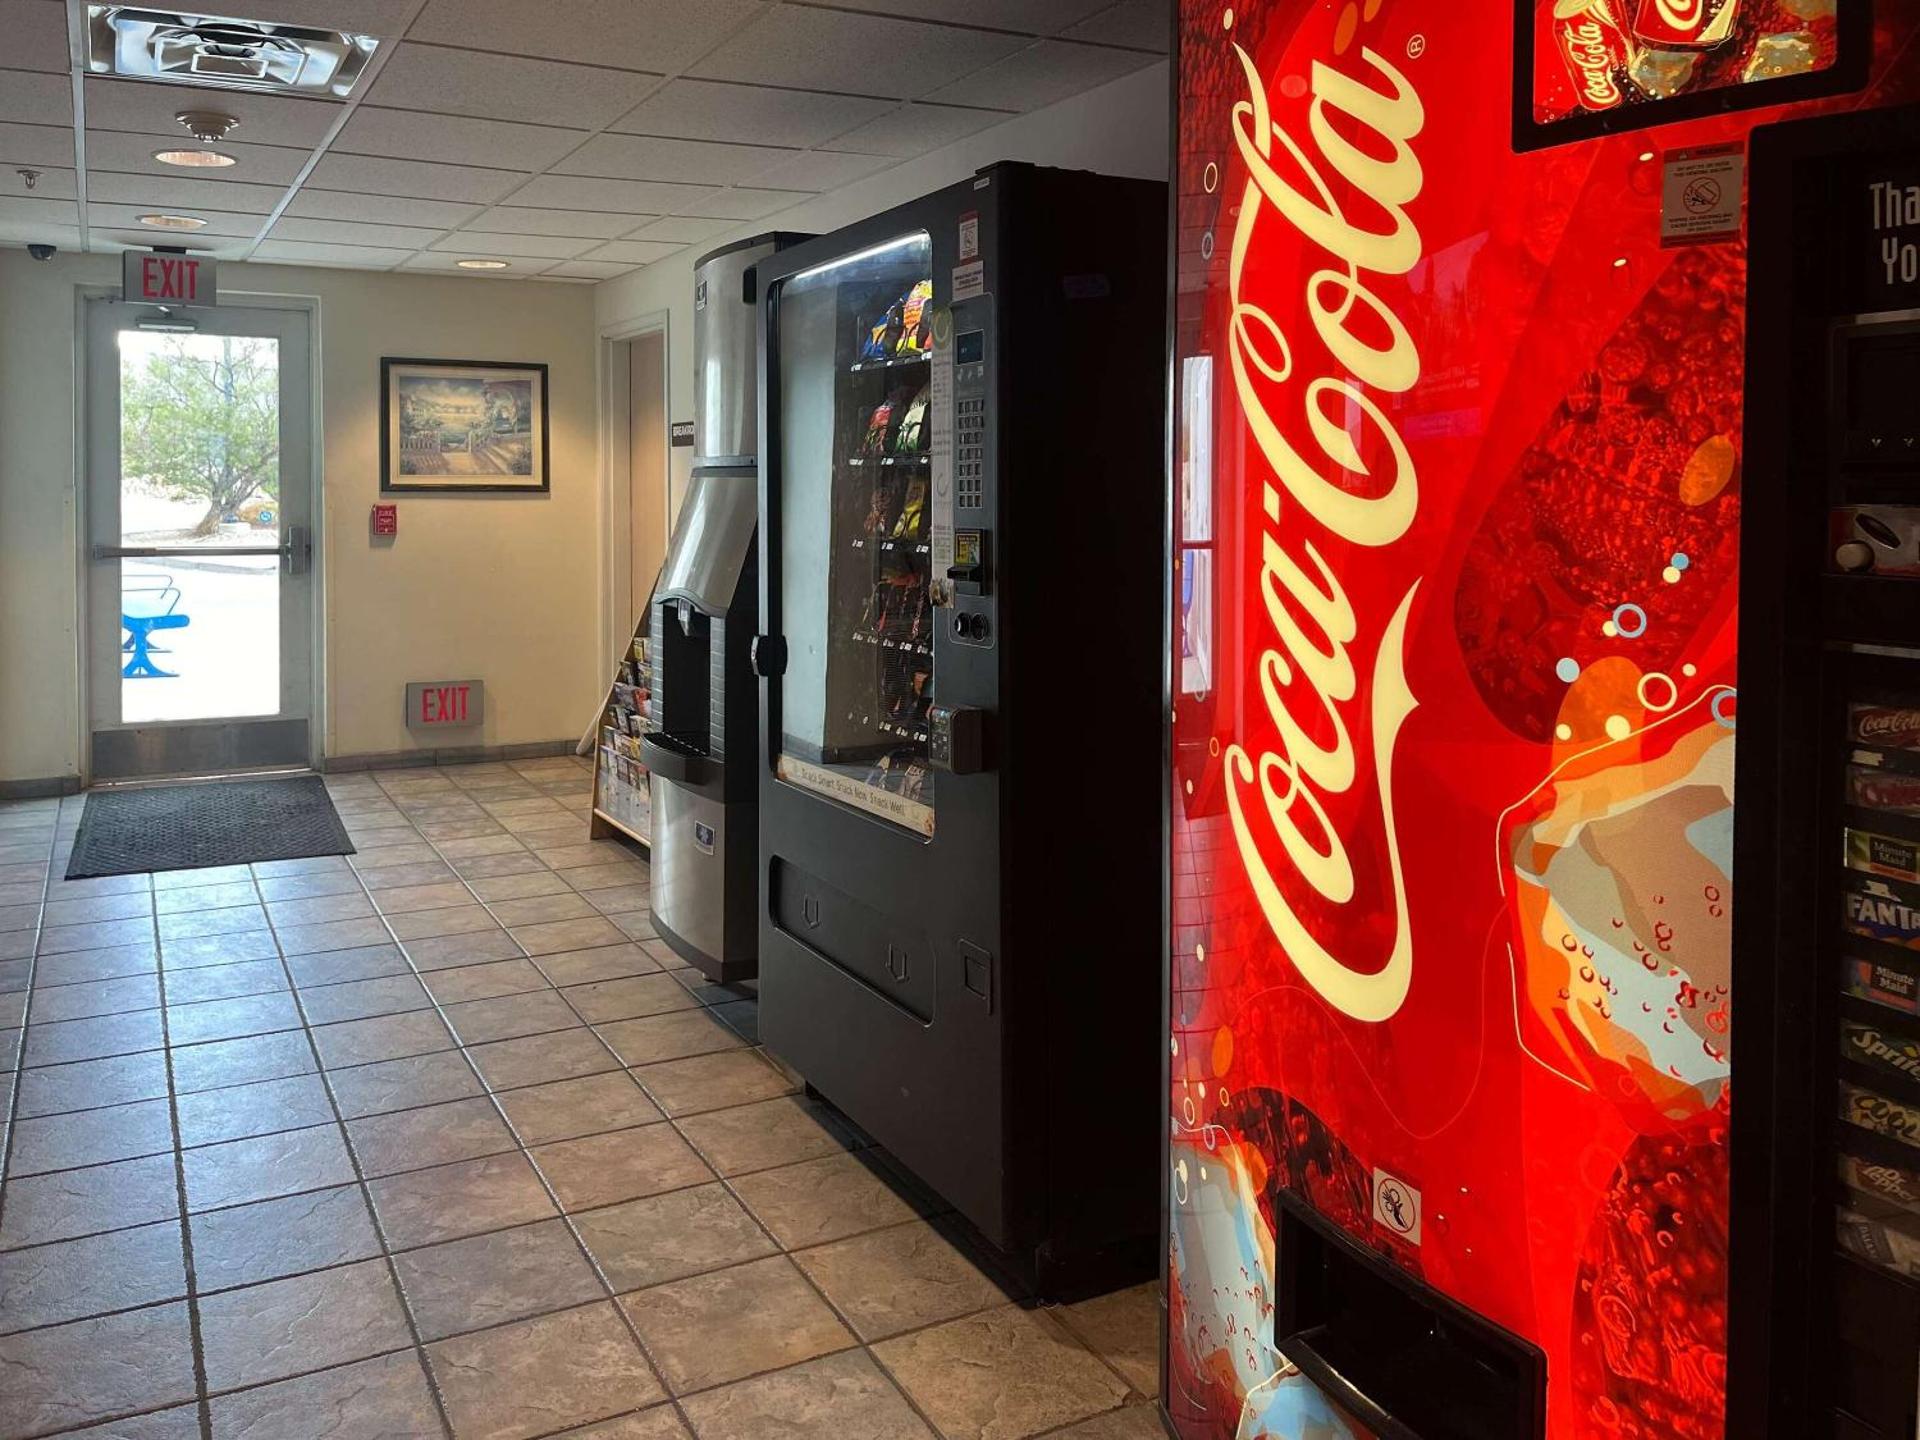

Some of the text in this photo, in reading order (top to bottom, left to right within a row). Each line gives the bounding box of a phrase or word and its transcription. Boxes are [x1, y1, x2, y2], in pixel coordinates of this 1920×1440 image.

[1563, 20, 1621, 105] Coca-Cola
[143, 256, 200, 300] EXIT
[1227, 40, 1426, 1022] Coca-Cola
[422, 686, 471, 723] EXIT
